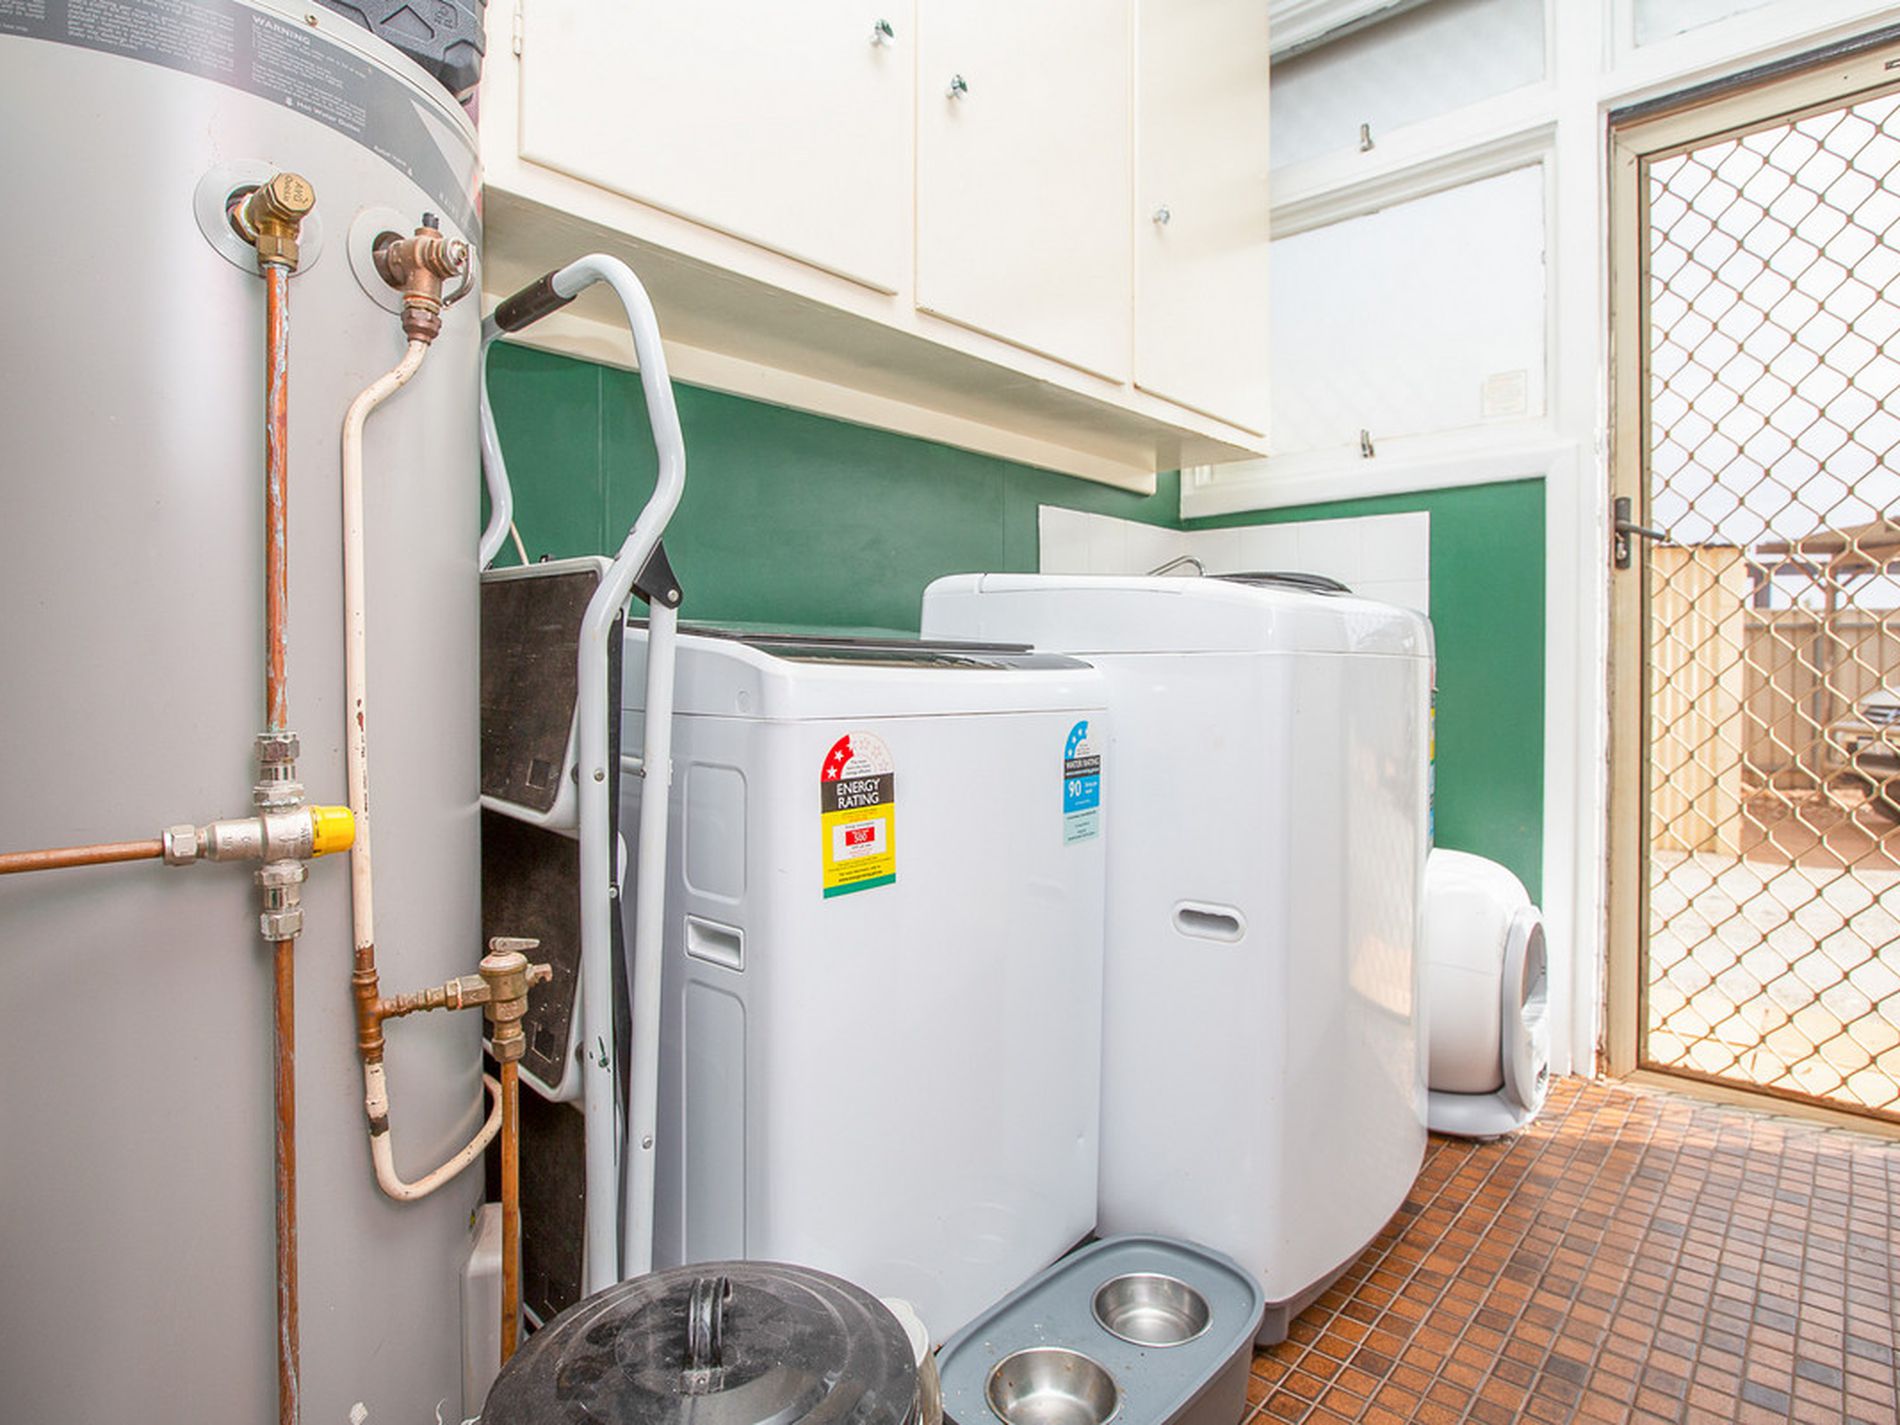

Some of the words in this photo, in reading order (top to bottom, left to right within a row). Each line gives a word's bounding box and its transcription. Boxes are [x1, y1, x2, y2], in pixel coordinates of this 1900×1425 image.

[252, 14, 310, 50] WARNING
[836, 779, 880, 796] ENERGY
[1068, 779, 1082, 798] 90
[838, 792, 879, 809] RATING
